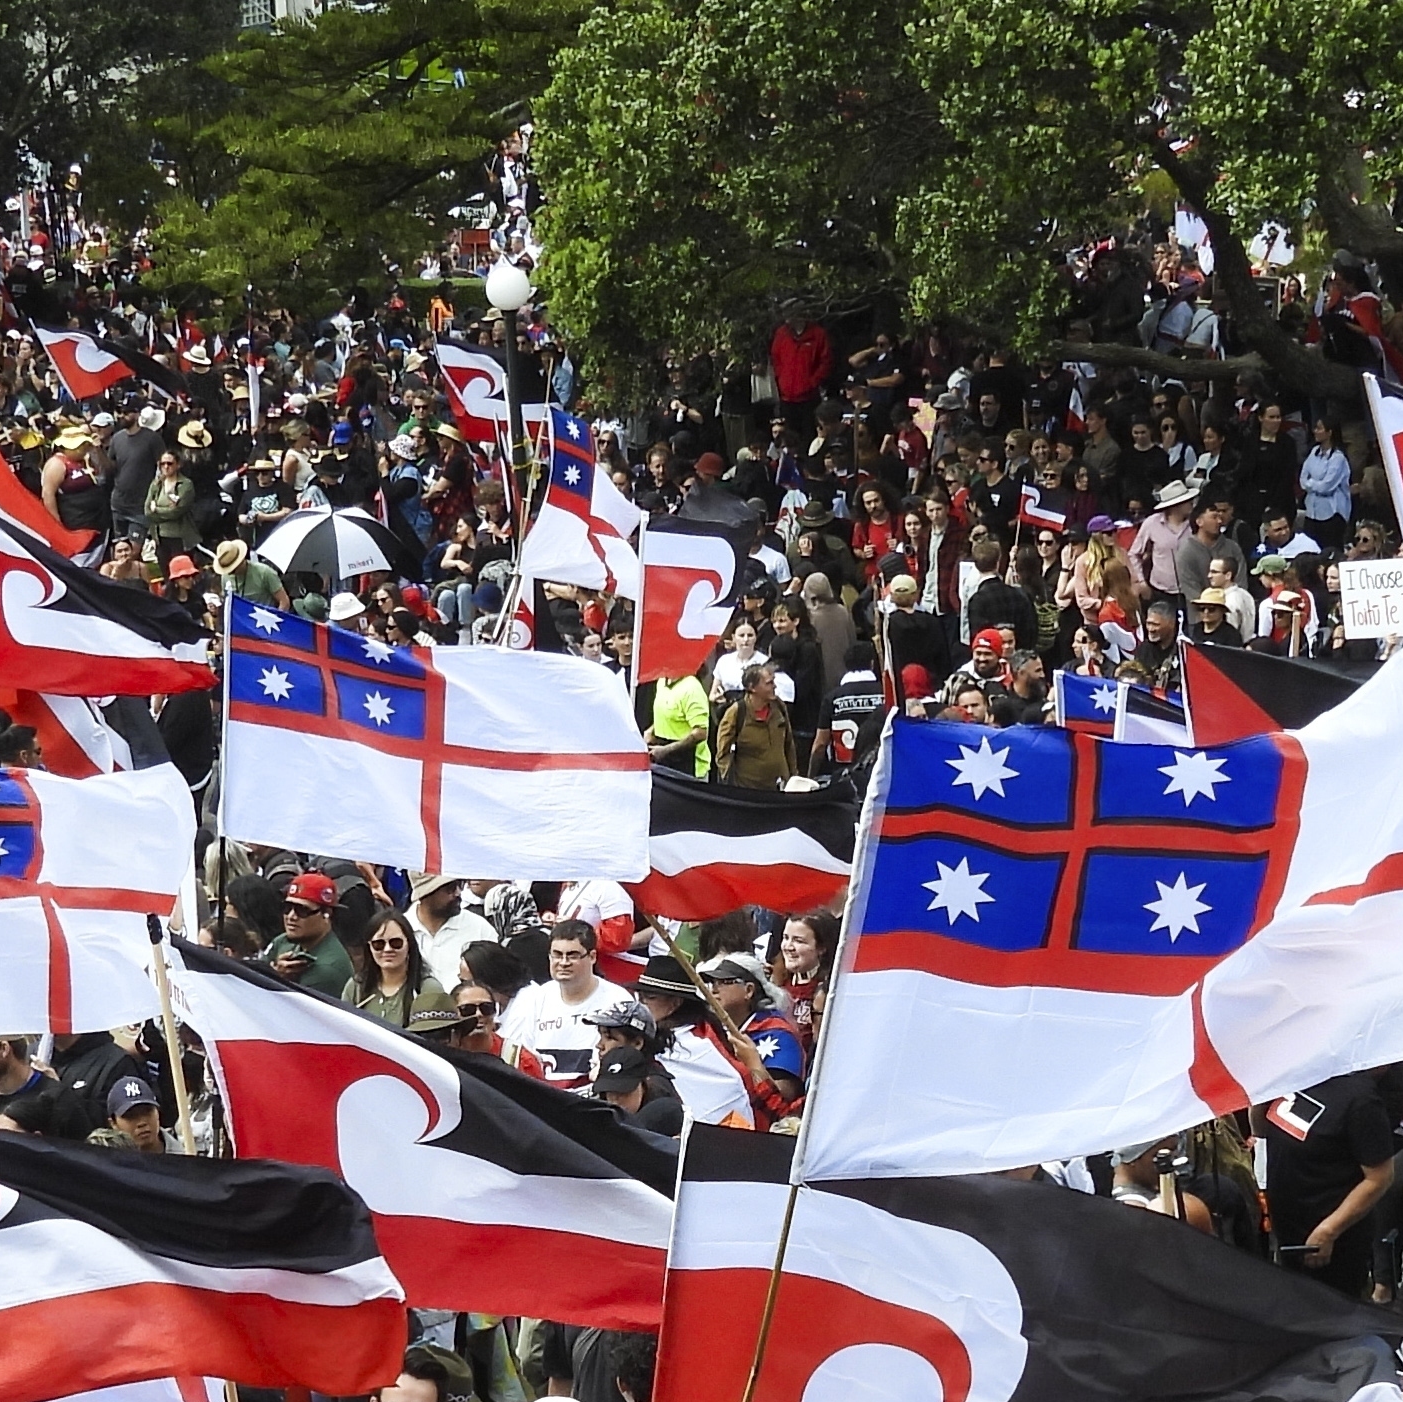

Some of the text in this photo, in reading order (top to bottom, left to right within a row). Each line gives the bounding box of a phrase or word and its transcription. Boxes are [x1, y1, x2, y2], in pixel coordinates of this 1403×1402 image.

[1345, 569, 1355, 590] I
[1359, 567, 1403, 590] Choose
[1381, 594, 1399, 626] Te
